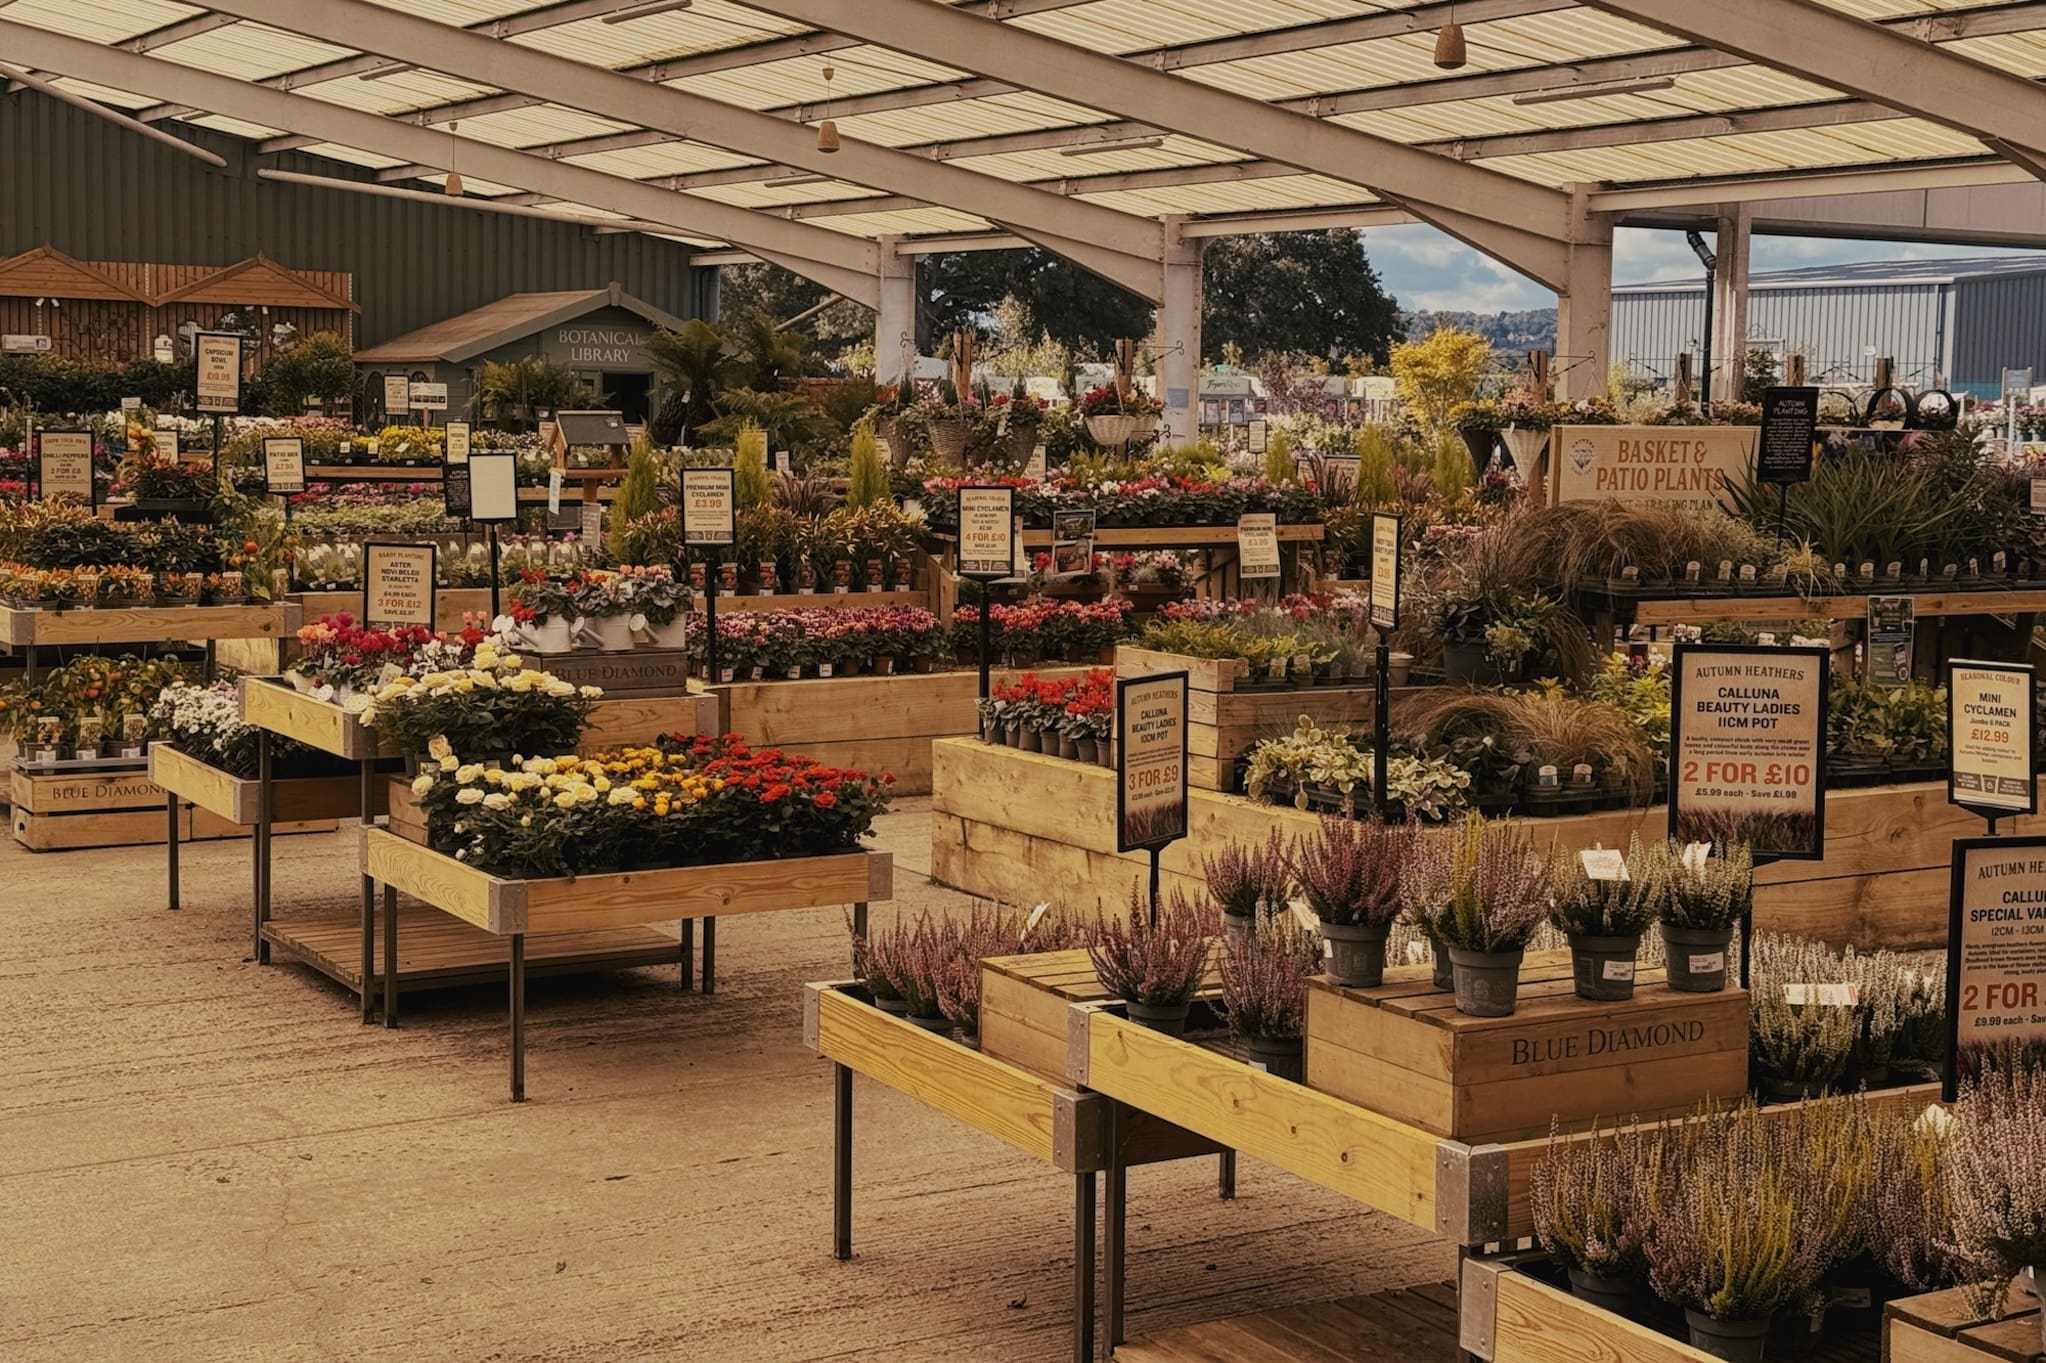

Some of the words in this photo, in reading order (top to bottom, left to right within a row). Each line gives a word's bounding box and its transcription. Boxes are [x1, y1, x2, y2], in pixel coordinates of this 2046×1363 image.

[560, 330, 640, 345] BOTANICAL
[571, 347, 631, 363] LIBRARY
[1773, 407, 1808, 415] PLANTING
[1617, 439, 1691, 464] BASKET
[1693, 440, 1707, 463] &
[1595, 467, 1649, 491] PATIO
[1653, 467, 1726, 492] PLANTS
[965, 532, 971, 541] 4
[972, 533, 990, 541] FOR
[991, 533, 1006, 542] £10
[381, 575, 419, 583] STARLETTA
[377, 599, 384, 607] 3
[385, 599, 404, 608] FOR
[405, 600, 422, 609] £12
[555, 667, 596, 681] BLUE
[602, 664, 677, 680] DIAMOND
[1695, 665, 1742, 679] AUTUMN
[1745, 665, 1805, 681] HEATHERS
[1960, 672, 1994, 682] SEASONAL
[1995, 674, 2021, 685] COLOUR
[1131, 692, 1151, 706] AUTUMN
[1152, 690, 1179, 701] HEATHERS
[1718, 687, 1780, 700] CALLUNA
[1979, 692, 2001, 704] MINI
[1140, 707, 1168, 720] CALLUNA
[1696, 701, 1750, 714] BEAUTY
[1753, 703, 1801, 715] LADIES
[1963, 704, 2017, 718] CYCLAMEN
[1132, 722, 1155, 734] BEAUTY
[1155, 717, 1177, 730] LADIES
[1751, 717, 1779, 729] POT
[1994, 719, 2011, 728] PACK
[1156, 730, 1169, 740] POT
[1970, 728, 2010, 744] £12.99
[1128, 773, 1136, 791] 3
[1138, 768, 1161, 789] FOR
[1163, 764, 1179, 784] £9
[1683, 761, 1699, 783] 2
[1706, 762, 1757, 784] FOR
[1763, 763, 1810, 786] £10
[52, 787, 89, 800] BLUE
[1695, 788, 1722, 797] £5.99
[1723, 788, 1744, 797] each
[1751, 789, 1771, 798] Save
[1773, 790, 1797, 799] £1.98
[1978, 861, 2026, 879] AUTUMN
[2002, 890, 2046, 904] CALLU
[1970, 907, 2024, 922] SPECIAL
[1991, 925, 2014, 936] 12CM
[2021, 924, 2045, 935] 13CM
[1962, 984, 1978, 1011] 2
[1986, 982, 2038, 1009] FOR
[1974, 1016, 2001, 1027] £9.99
[2003, 1015, 2024, 1025] each
[1511, 1035, 1579, 1066] BLUE
[1587, 1020, 1705, 1056] DIAMOND
